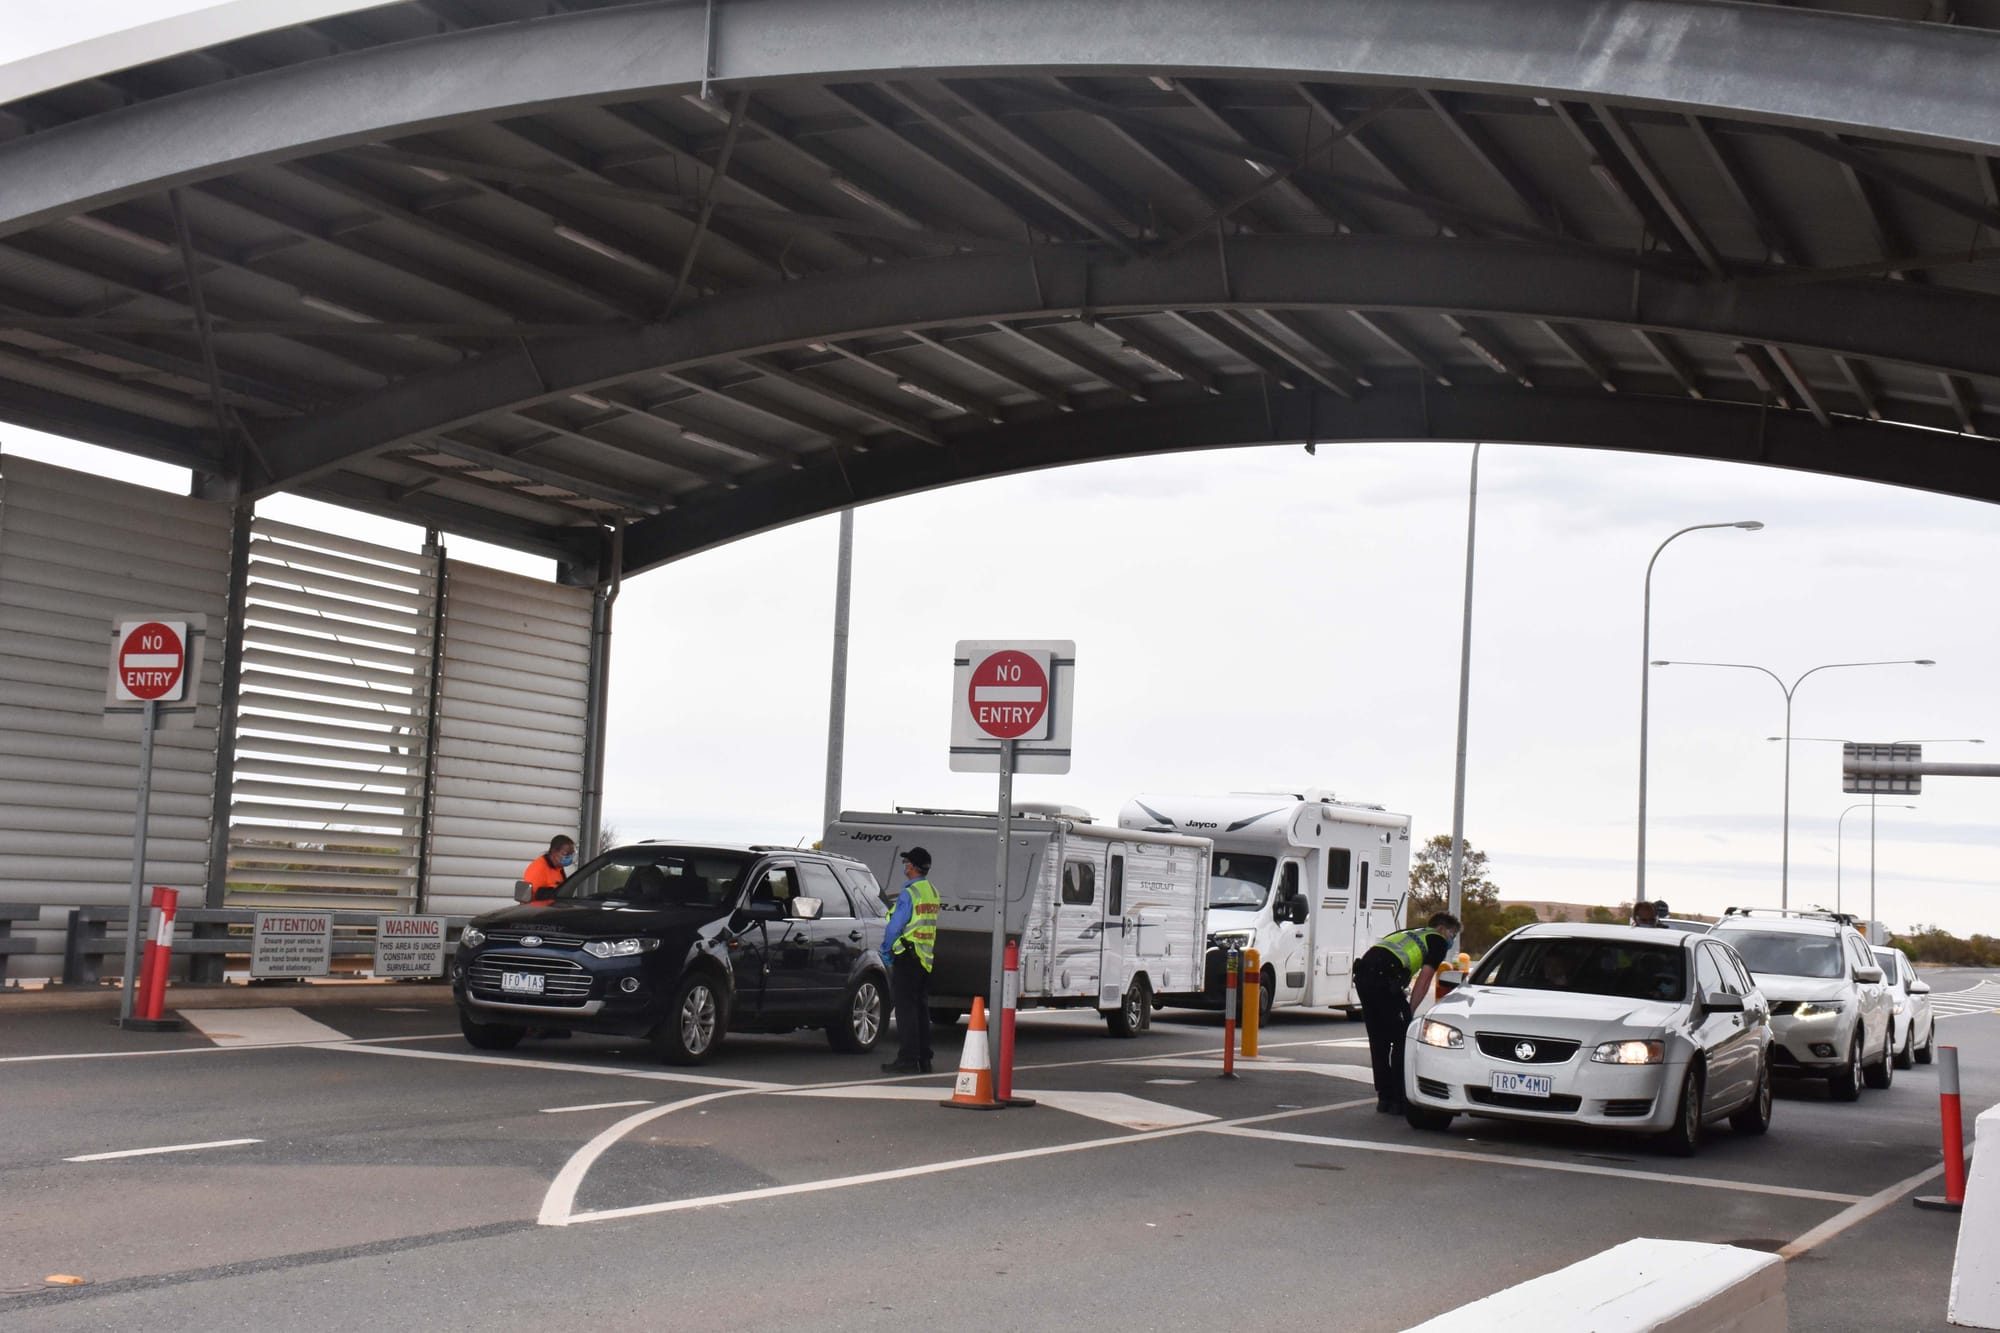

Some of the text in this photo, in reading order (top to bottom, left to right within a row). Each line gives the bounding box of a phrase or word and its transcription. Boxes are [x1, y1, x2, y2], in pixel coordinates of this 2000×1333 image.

[141, 635, 163, 650] NO
[127, 671, 173, 687] ENTRY
[996, 664, 1021, 682] NO
[979, 706, 1035, 724] ENTRY
[1185, 819, 1217, 829] Jayco
[851, 831, 892, 842] Jayco
[262, 918, 326, 932] ATTENTION
[385, 920, 439, 935] WARNING
[380, 942, 441, 950] THIS AREA IS UNDER
[383, 952, 436, 960] CONSTANT VIDEO
[386, 963, 431, 972] SURVEILLANCE
[1525, 1078, 1549, 1092] 4MU
